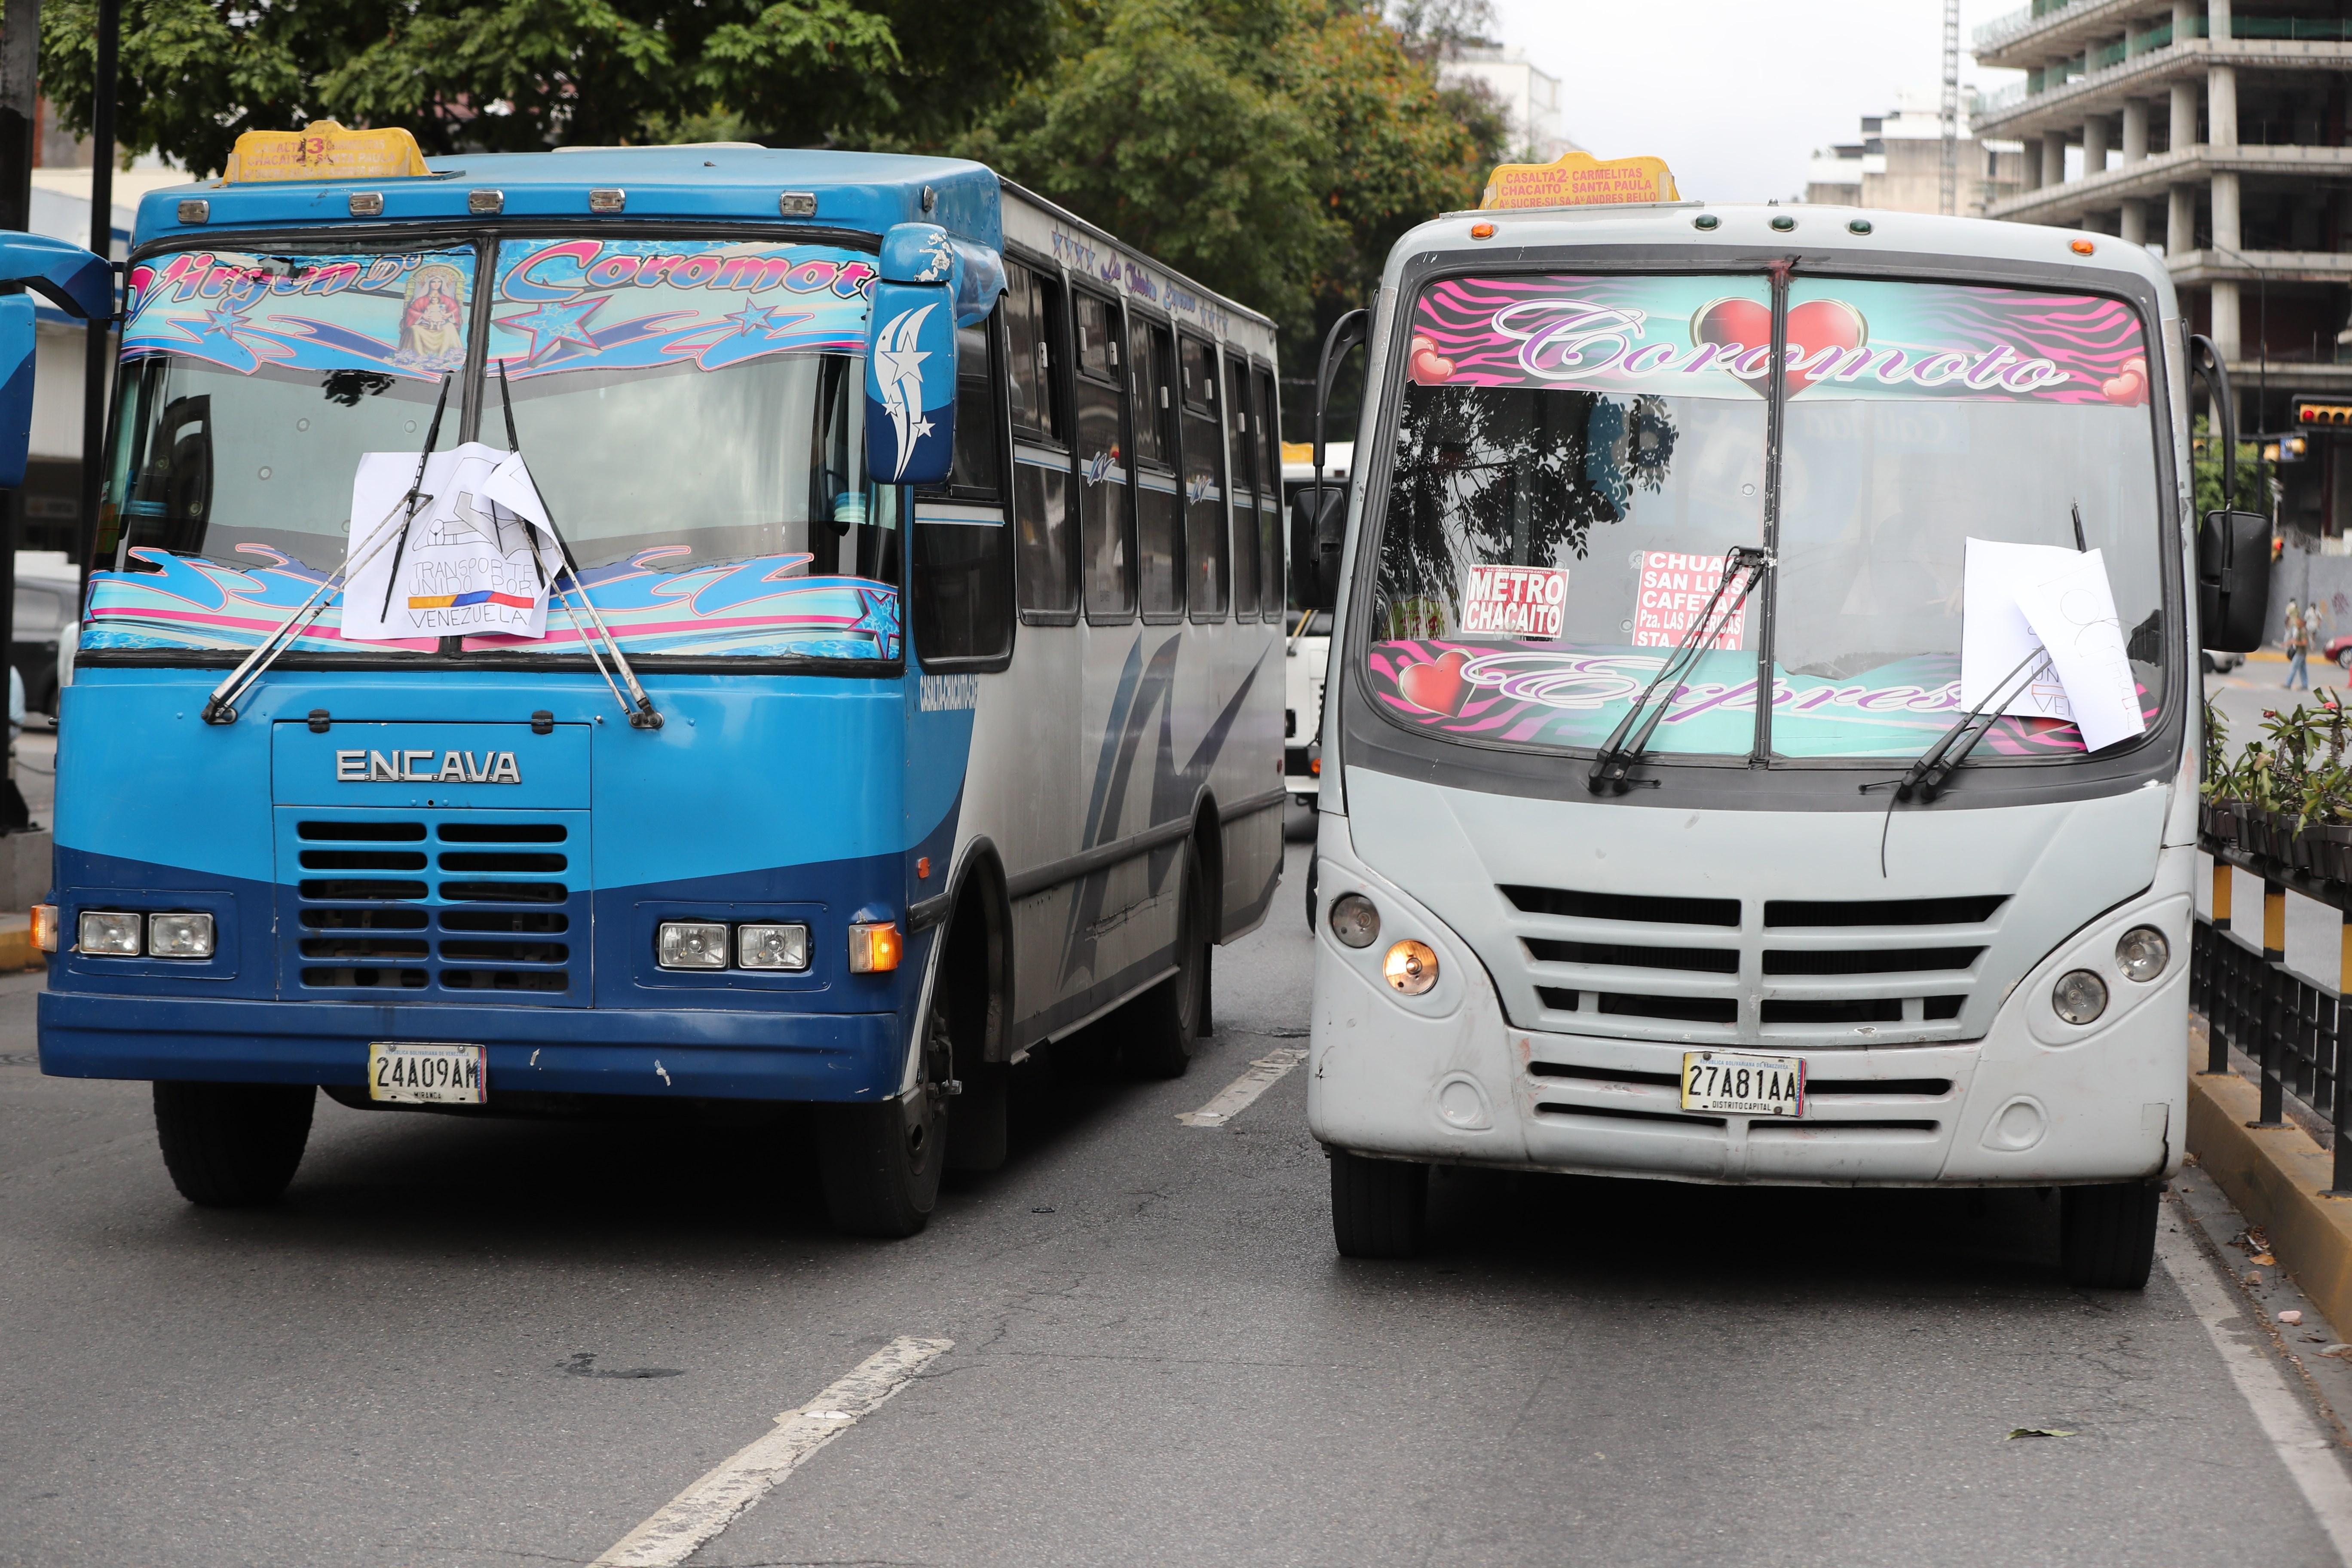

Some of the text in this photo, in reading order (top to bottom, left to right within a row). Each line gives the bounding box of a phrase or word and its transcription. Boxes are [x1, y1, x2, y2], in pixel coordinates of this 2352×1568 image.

[307, 137, 324, 154] 3
[1501, 184, 1561, 196] CHACAITO
[1572, 181, 1611, 193] SANTA
[1614, 179, 1652, 191] PAULA
[1506, 172, 1556, 184] CASALTA
[1572, 168, 1642, 181] CARMELITAS
[1586, 193, 1623, 205] ANDRES
[1626, 192, 1656, 202] BELLO
[1491, 297, 2070, 392] Coromoto
[413, 557, 534, 581] TRANSPORTE
[1644, 571, 1688, 591] SAN
[409, 575, 534, 596] UNIDO POR
[1469, 571, 1564, 605] METRO
[408, 604, 527, 628] VENEZUELA
[1467, 601, 1560, 633] CHACAITO
[1639, 609, 1660, 628] Pza.
[1663, 610, 1684, 631] LAS
[336, 750, 522, 784] ENCAVA
[377, 1057, 478, 1088] 24A09AM
[1688, 1065, 1796, 1101] 27A81AA
